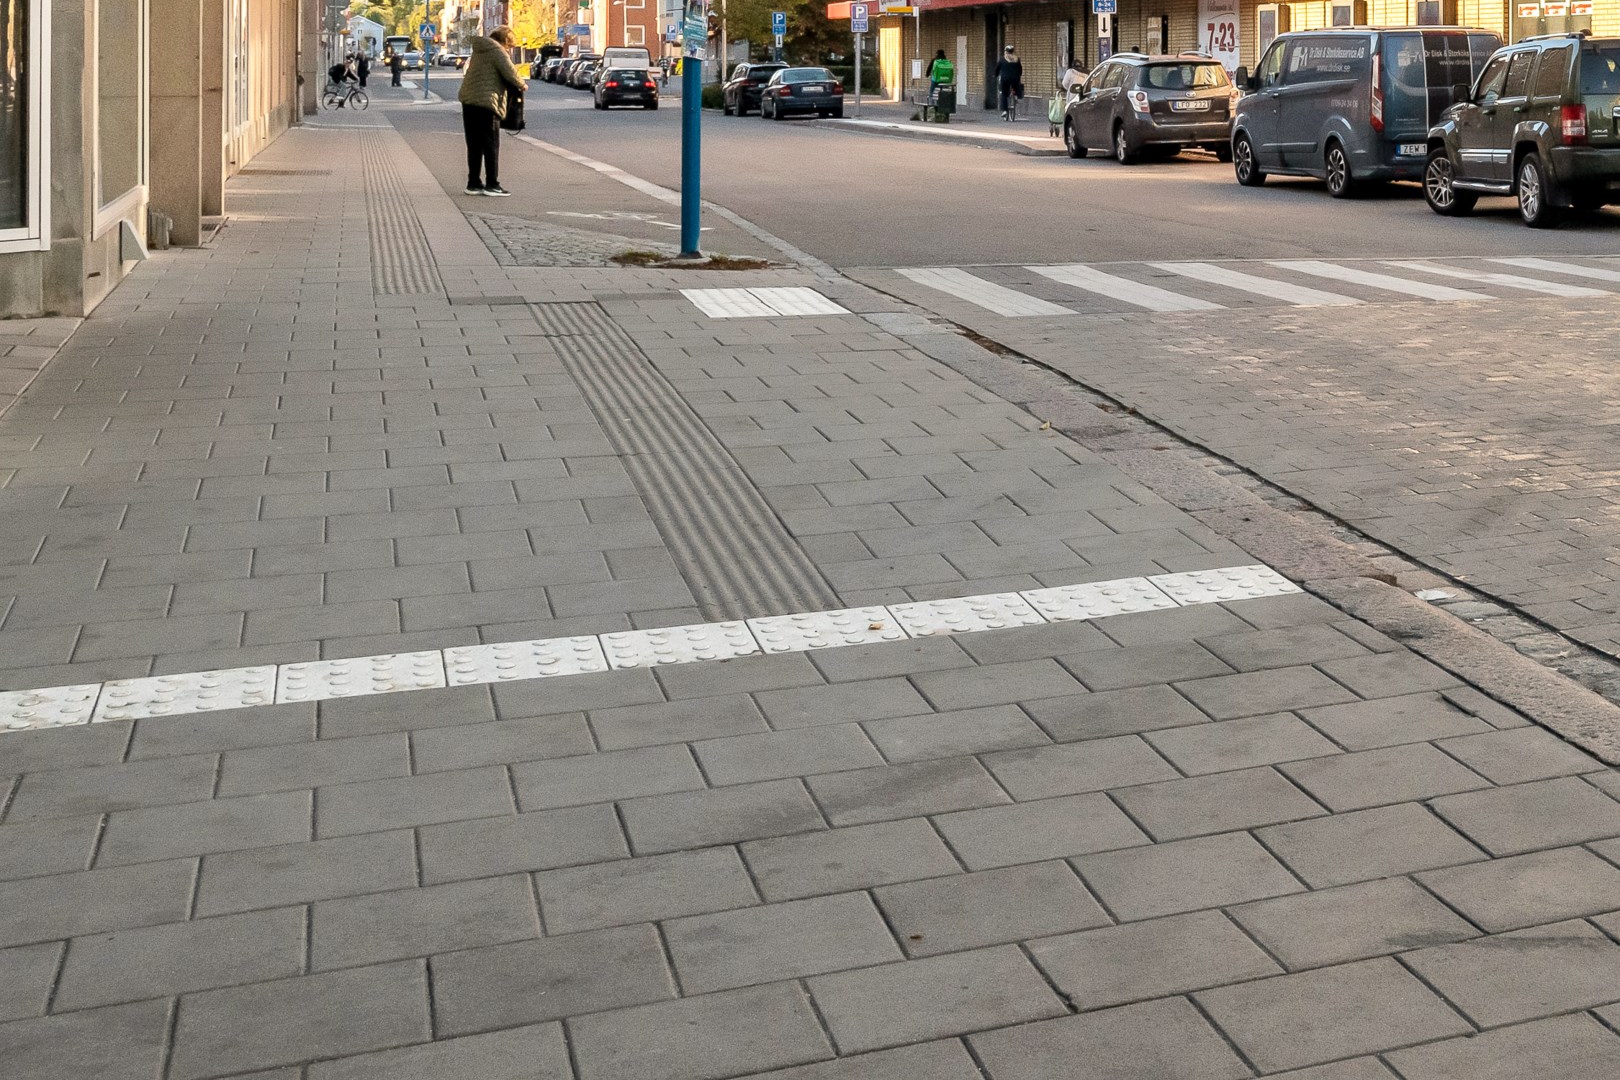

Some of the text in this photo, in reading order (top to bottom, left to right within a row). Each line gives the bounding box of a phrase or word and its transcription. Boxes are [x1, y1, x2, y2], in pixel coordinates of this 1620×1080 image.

[856, 7, 865, 18] P
[776, 13, 783, 23] P
[668, 25, 675, 33] P
[1404, 145, 1420, 153] ZEW
